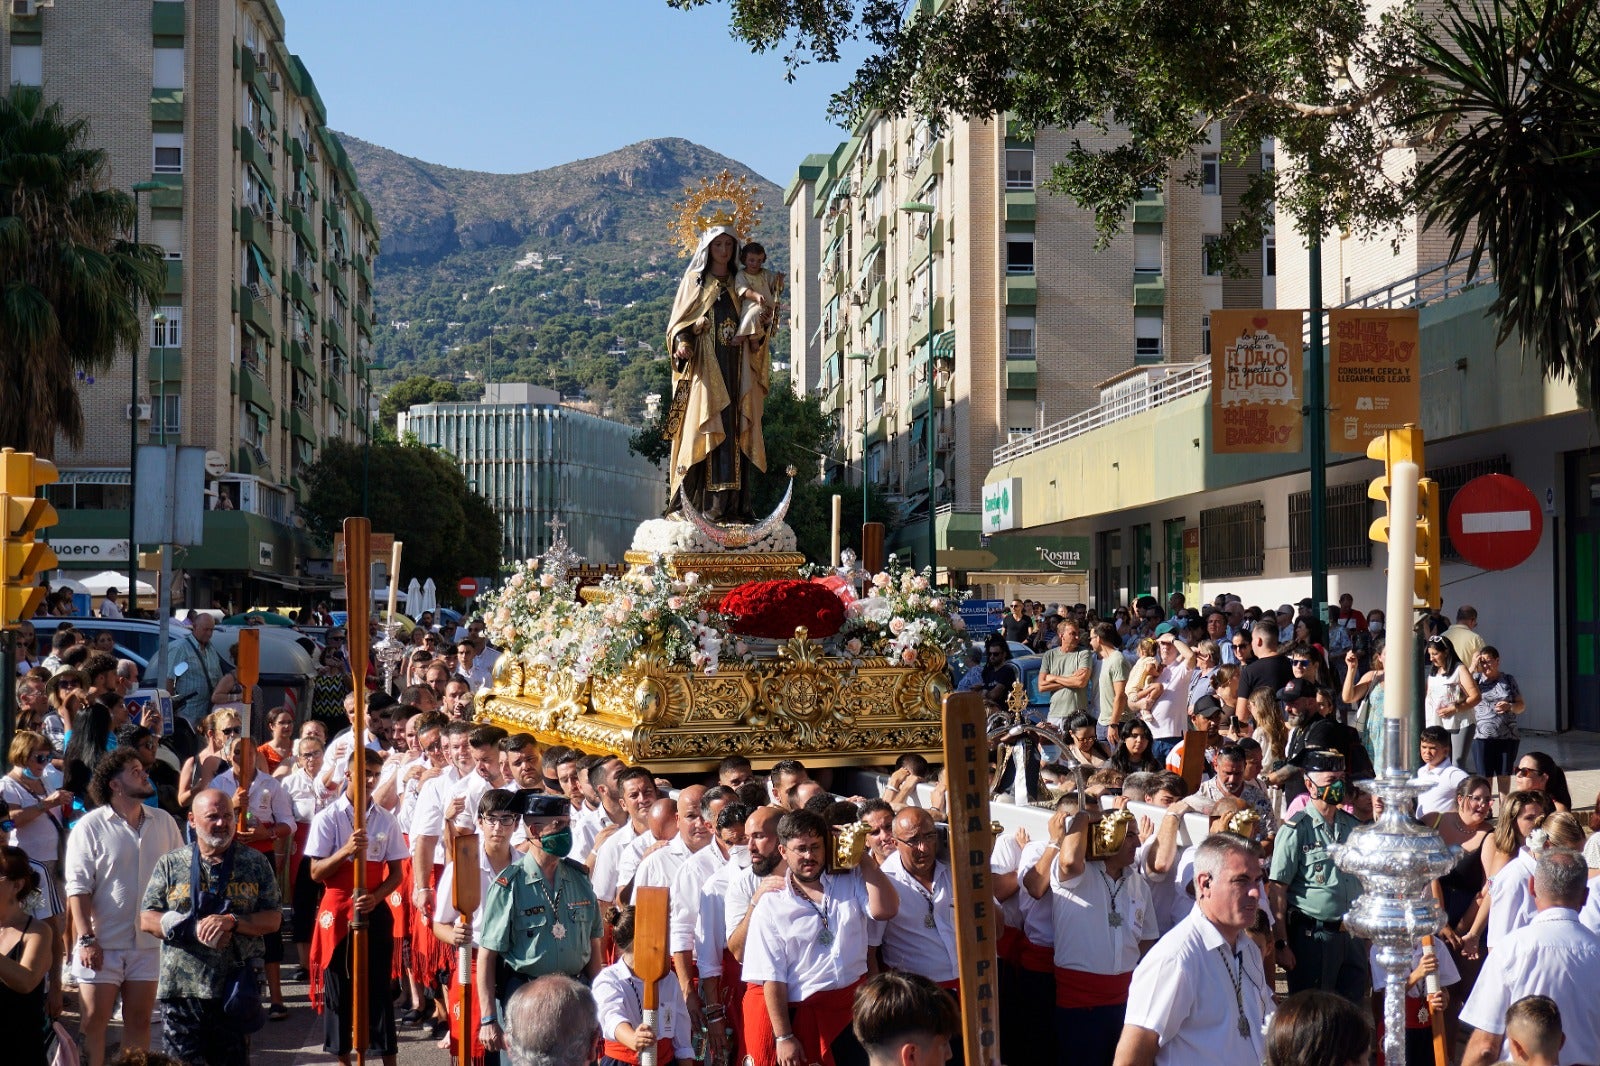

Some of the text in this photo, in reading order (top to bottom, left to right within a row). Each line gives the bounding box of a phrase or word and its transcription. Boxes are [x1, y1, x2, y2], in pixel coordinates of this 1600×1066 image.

[1253, 333, 1270, 344] que
[1236, 343, 1262, 354] pasa
[1338, 367, 1410, 376] CONSUME CERCA Y
[1338, 375, 1411, 384] LLEGAREMOS LEJOS
[1039, 548, 1081, 566] Rosma
[961, 721, 983, 833] REINA
[969, 849, 985, 891] DE
[973, 901, 988, 943] EL
[976, 959, 995, 1048] PALO
